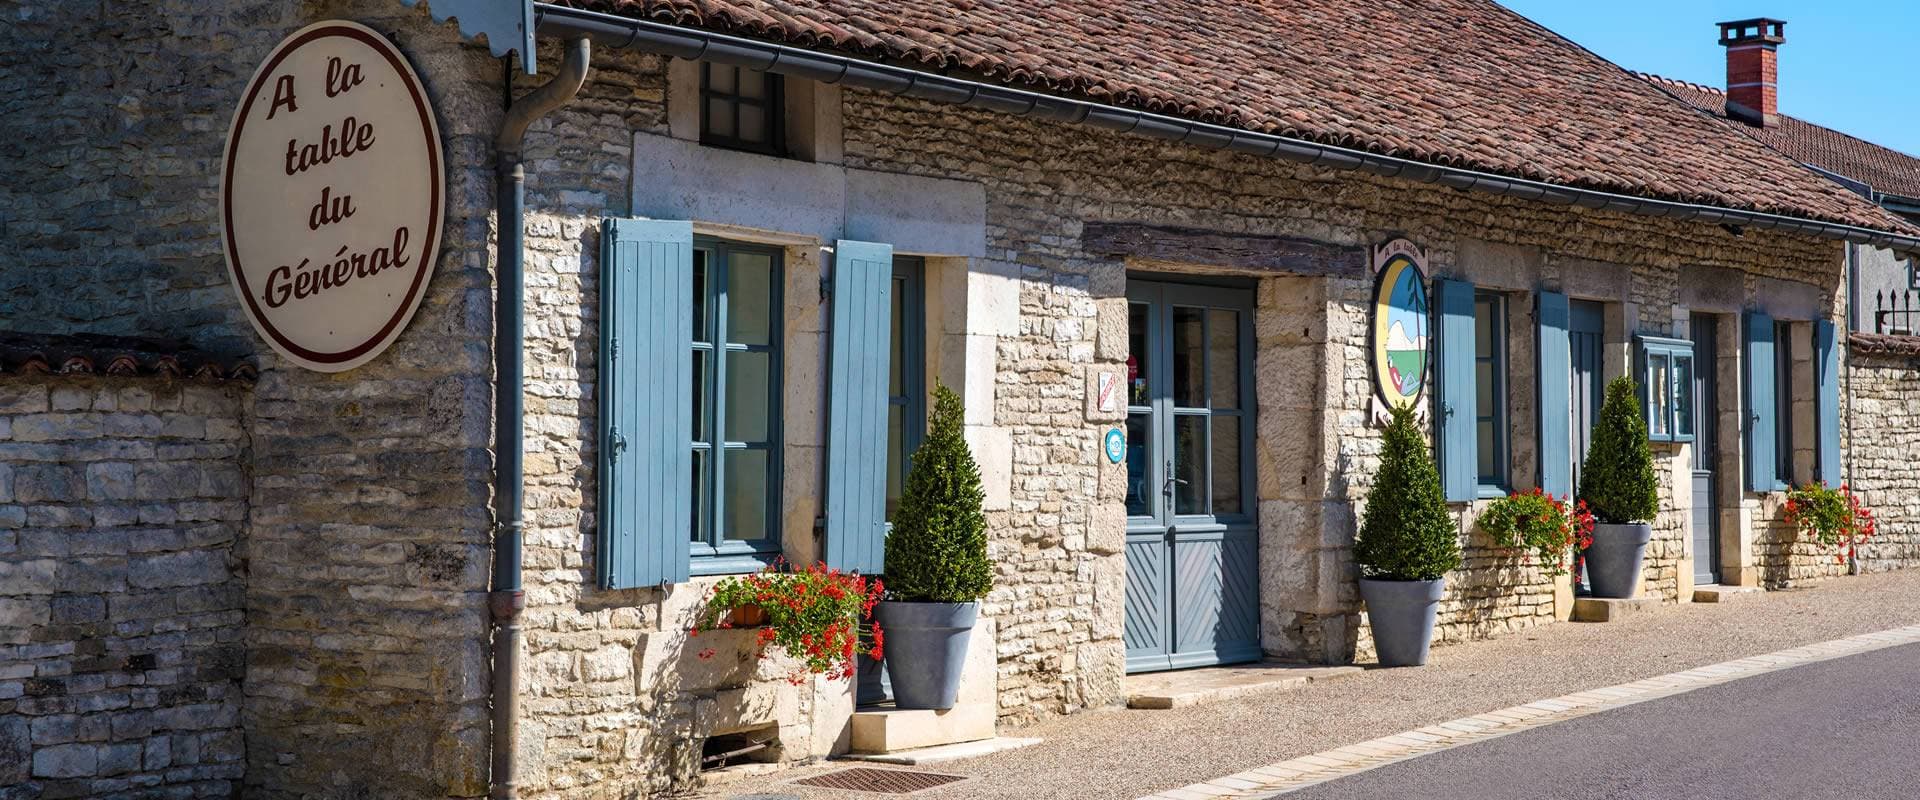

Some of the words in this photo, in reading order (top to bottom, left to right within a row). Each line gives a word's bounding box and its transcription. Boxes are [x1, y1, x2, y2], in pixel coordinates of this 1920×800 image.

[266, 74, 298, 120] A
[325, 56, 365, 98] la
[285, 116, 376, 176] table
[309, 186, 356, 231] du
[264, 226, 410, 309] Général
